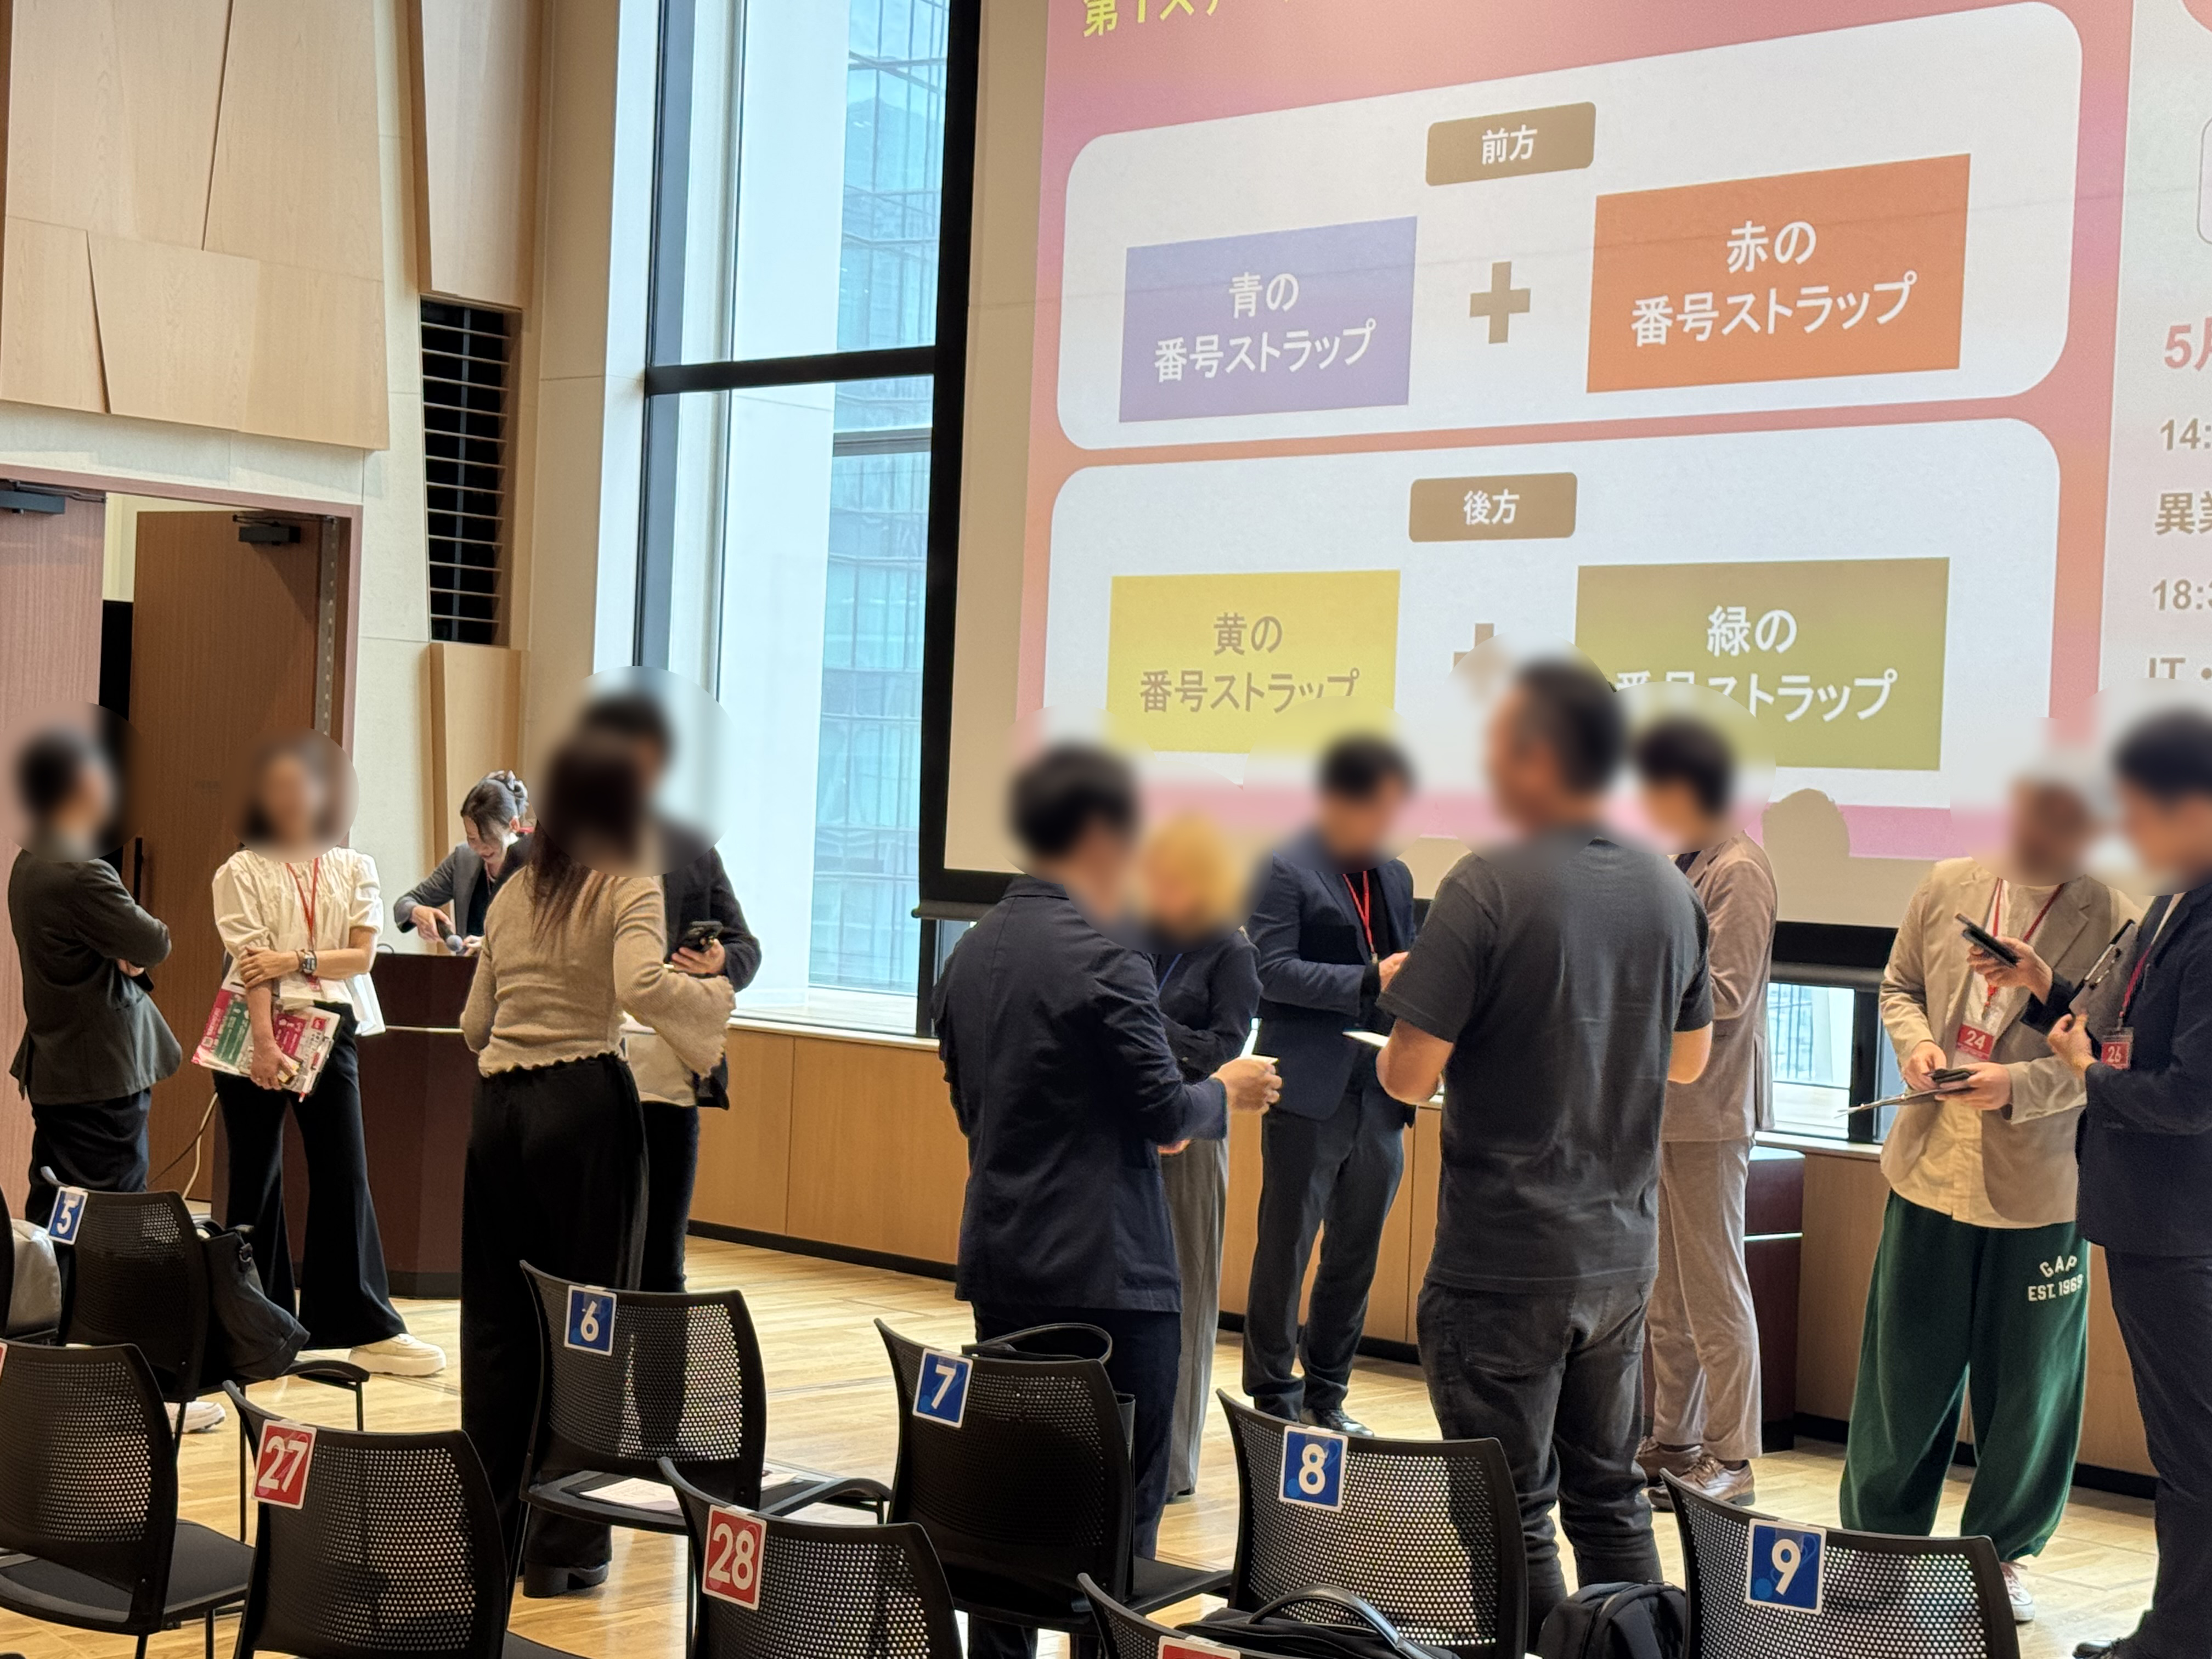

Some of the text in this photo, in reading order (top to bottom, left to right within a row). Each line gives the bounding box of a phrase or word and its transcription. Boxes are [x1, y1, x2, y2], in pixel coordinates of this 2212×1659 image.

[1481, 125, 1538, 165] 前方
[1726, 221, 1818, 273] 赤の
[1228, 272, 1299, 319] 青の
[1630, 270, 1917, 347] 番号ストラップ
[1154, 318, 1376, 382] 番号ストラップ
[1463, 490, 1520, 525] 後方
[2153, 579, 2212, 610] 18:
[1213, 612, 1282, 656] 黄の
[1706, 605, 1797, 656] 緑の
[1964, 1031, 1986, 1049] 24
[2107, 1046, 2121, 1063] 26
[56, 1197, 76, 1235] 5
[2039, 1255, 2078, 1278] GAP
[580, 1301, 599, 1342] 6
[931, 1365, 956, 1409] 7
[258, 1440, 306, 1493] 27
[1300, 1443, 1325, 1494] 8
[708, 1523, 755, 1589] 28
[1771, 1538, 1801, 1596] 9
